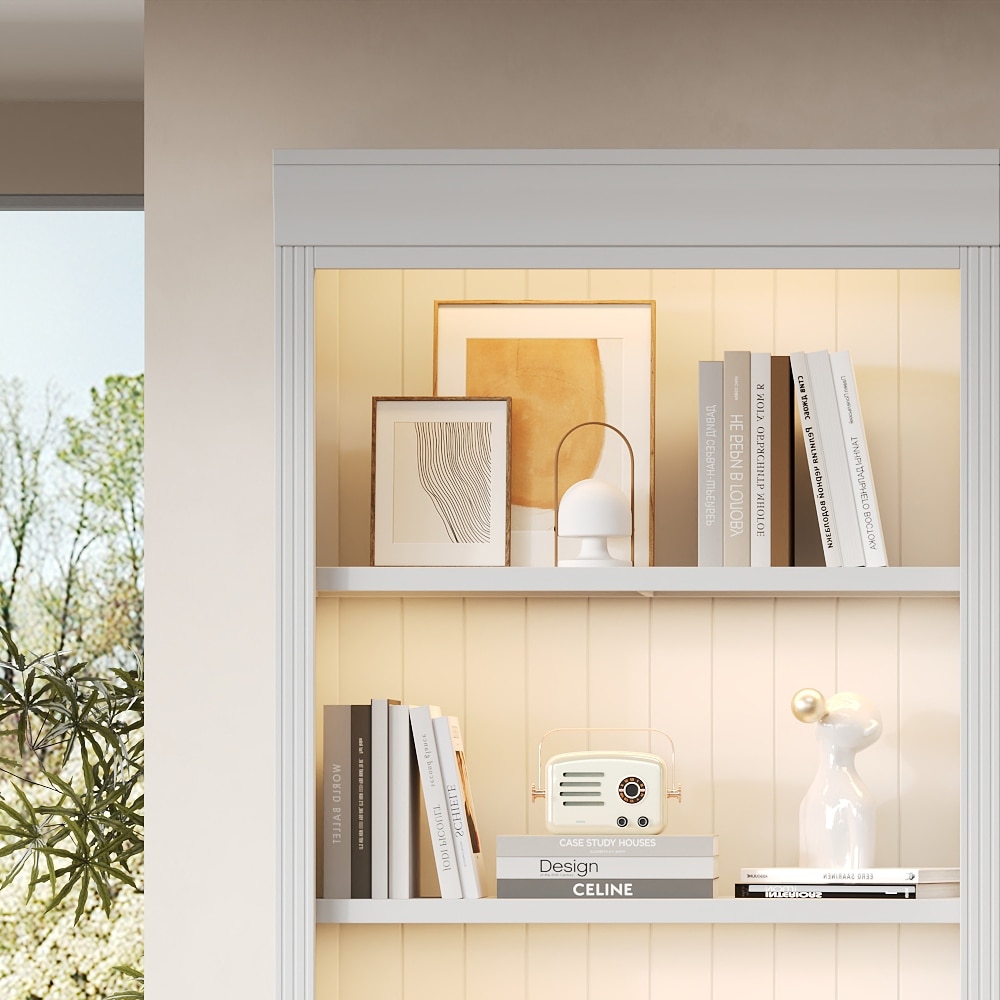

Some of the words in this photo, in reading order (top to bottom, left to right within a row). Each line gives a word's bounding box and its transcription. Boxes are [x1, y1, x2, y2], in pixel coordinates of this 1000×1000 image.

[559, 838, 584, 848] CASE
[586, 838, 616, 848] STUDY
[618, 838, 656, 848] HOUSES
[540, 858, 599, 877] Design
[572, 882, 634, 896] CELINE
